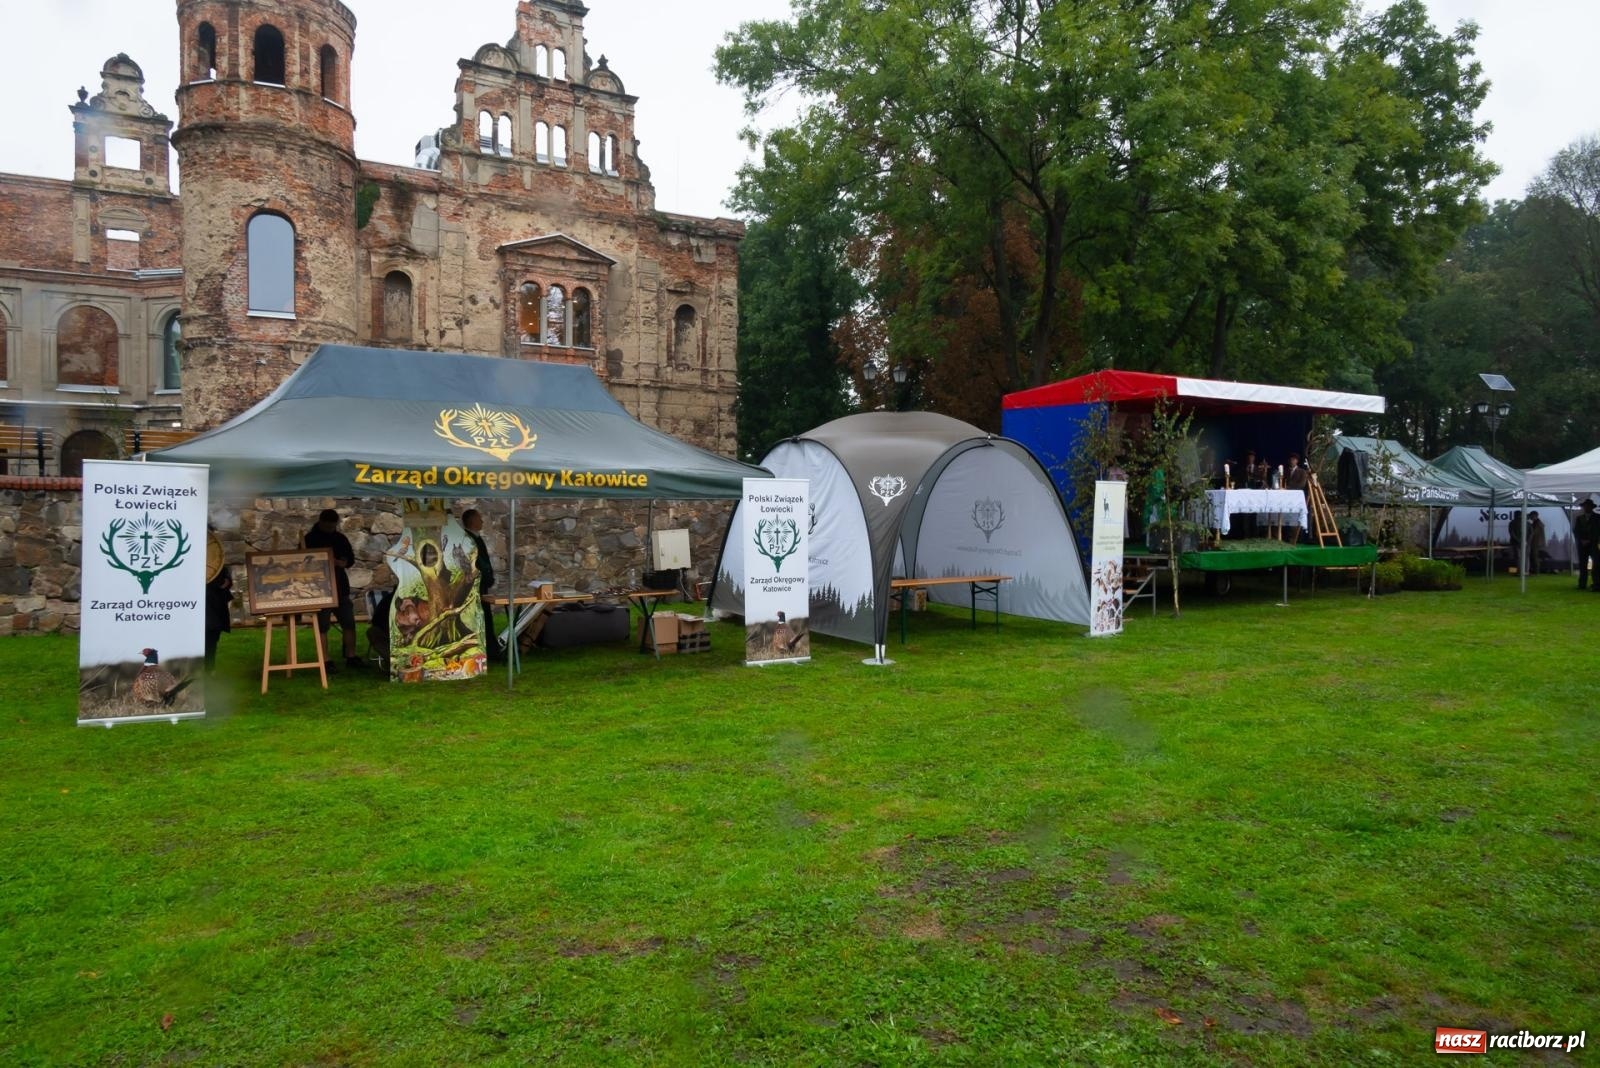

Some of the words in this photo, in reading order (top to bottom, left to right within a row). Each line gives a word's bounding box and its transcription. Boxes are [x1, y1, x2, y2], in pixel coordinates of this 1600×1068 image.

[473, 436, 514, 448] PZŁ
[355, 463, 438, 490] Zarząd
[444, 466, 556, 490] Okręgowy
[560, 469, 648, 488] Katowice
[94, 483, 138, 495] Polski
[142, 485, 198, 498] Związek
[115, 498, 177, 510] Łowiecki
[748, 495, 773, 503] Polski
[774, 495, 804, 503] Związek
[760, 505, 794, 513] Łowiecki
[130, 553, 163, 568] PZŁ
[750, 577, 772, 585] Zarząd
[90, 600, 133, 611] Zarząd
[137, 599, 197, 610] Okręgowy
[115, 612, 171, 622] Katowice
